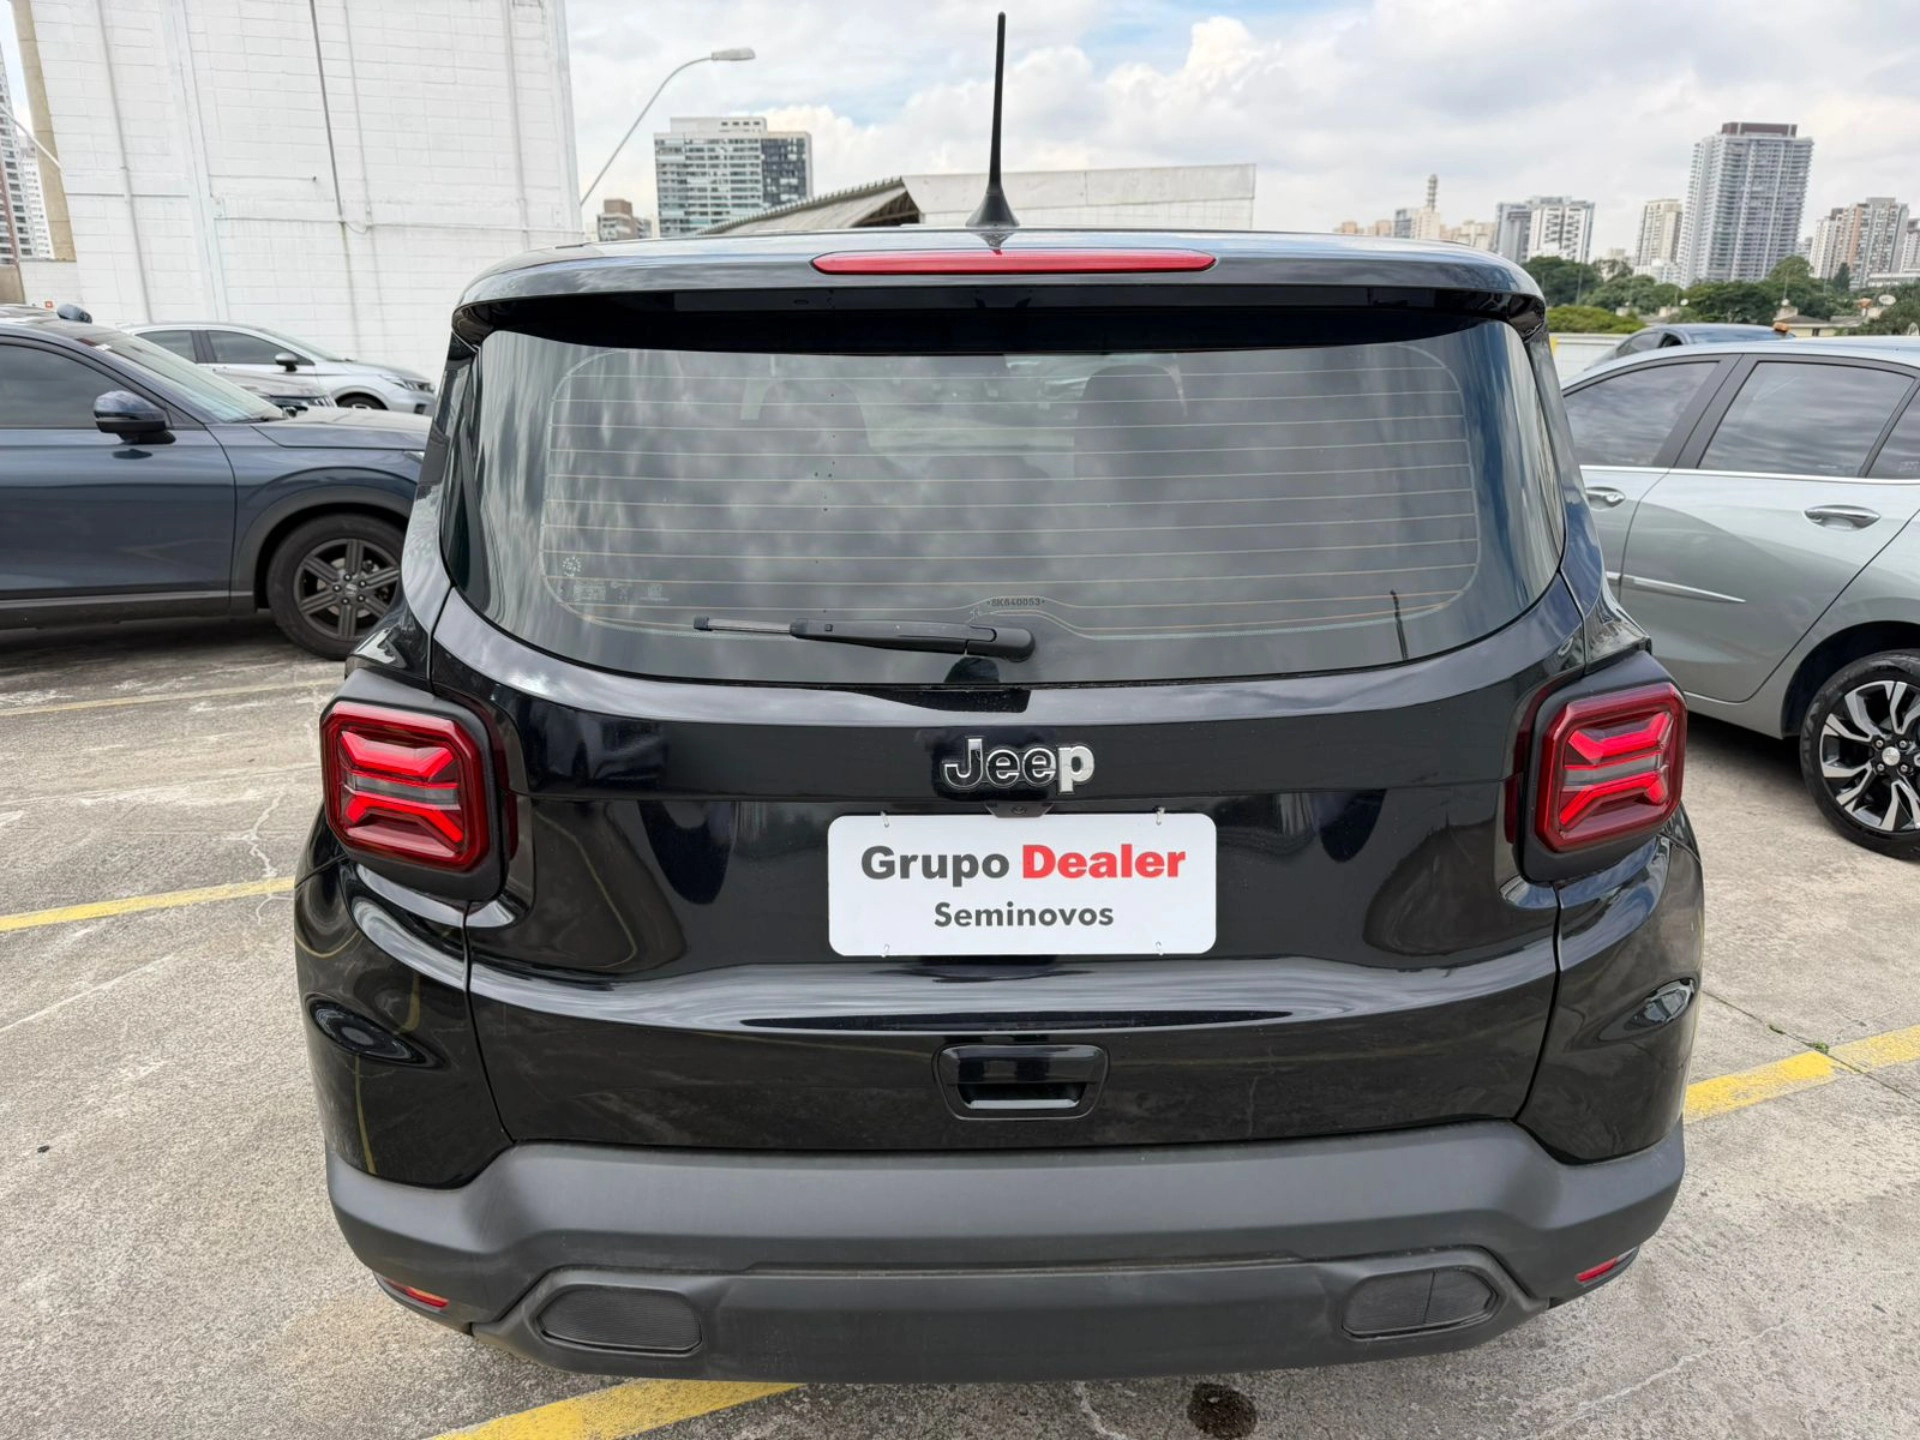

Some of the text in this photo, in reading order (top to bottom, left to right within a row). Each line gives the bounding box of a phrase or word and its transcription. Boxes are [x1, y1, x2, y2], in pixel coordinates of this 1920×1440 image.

[943, 737, 1095, 793] Jeep
[861, 844, 1186, 887] Grupo Dealer
[934, 901, 1114, 927] Seminovos
